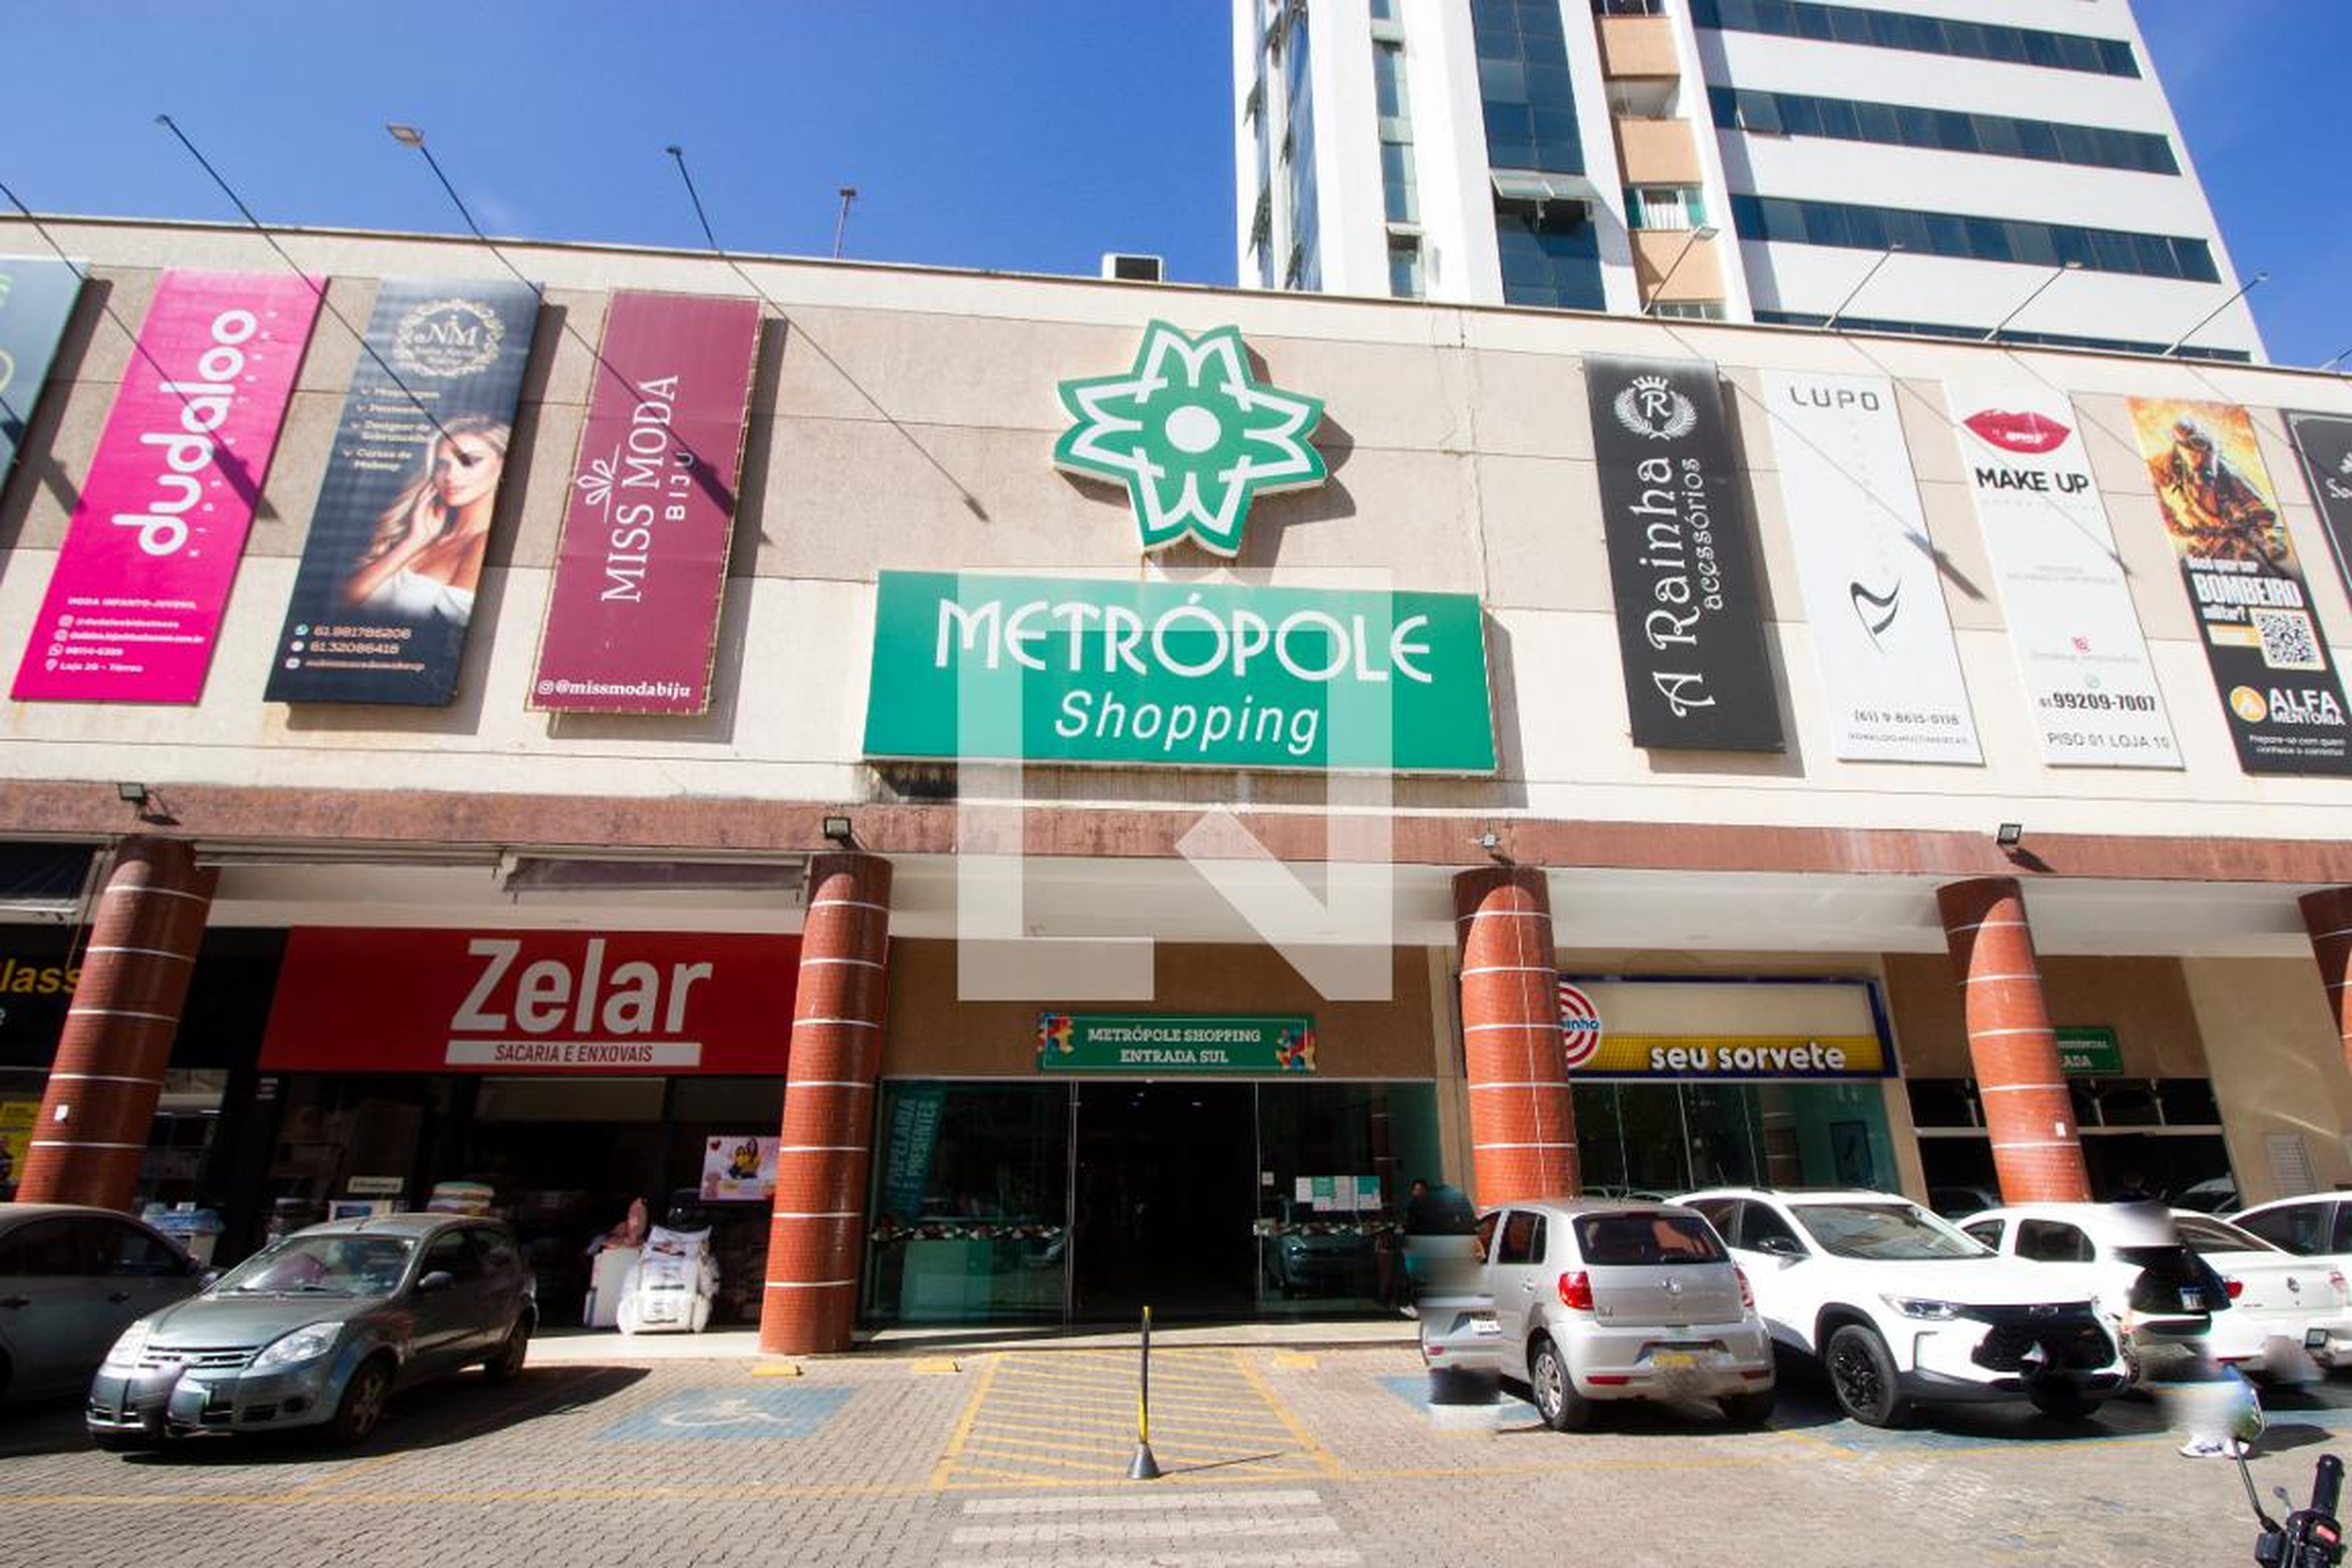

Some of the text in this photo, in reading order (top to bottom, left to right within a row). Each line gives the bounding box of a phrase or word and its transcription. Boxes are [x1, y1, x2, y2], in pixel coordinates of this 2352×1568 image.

[1790, 386, 1880, 411] LUPO
[112, 309, 257, 556] dudaloo
[601, 375, 679, 603] MISS MODA
[665, 451, 694, 521] BIJU
[1975, 467, 2089, 494] MAKE UP
[1681, 458, 1723, 611] acessórios
[1629, 457, 1716, 718] A Rainha
[2192, 573, 2305, 608] BOMBEIRO
[935, 592, 1433, 684] METRÓPOLE
[556, 679, 691, 701] @missmodabiju
[2269, 687, 2342, 715] ALFA
[1055, 690, 1319, 755] Shopping
[2271, 711, 2346, 726] MENTORIA
[0, 957, 81, 995] lass
[450, 938, 712, 1034] Zelar
[1087, 1025, 1261, 1043] METRÓPOLE SHOPPING
[494, 1044, 653, 1063] SACARIA E ENXOVAIS
[1120, 1049, 1229, 1064] ENTRADA SUL
[1649, 1041, 1846, 1071] seu sorvete
